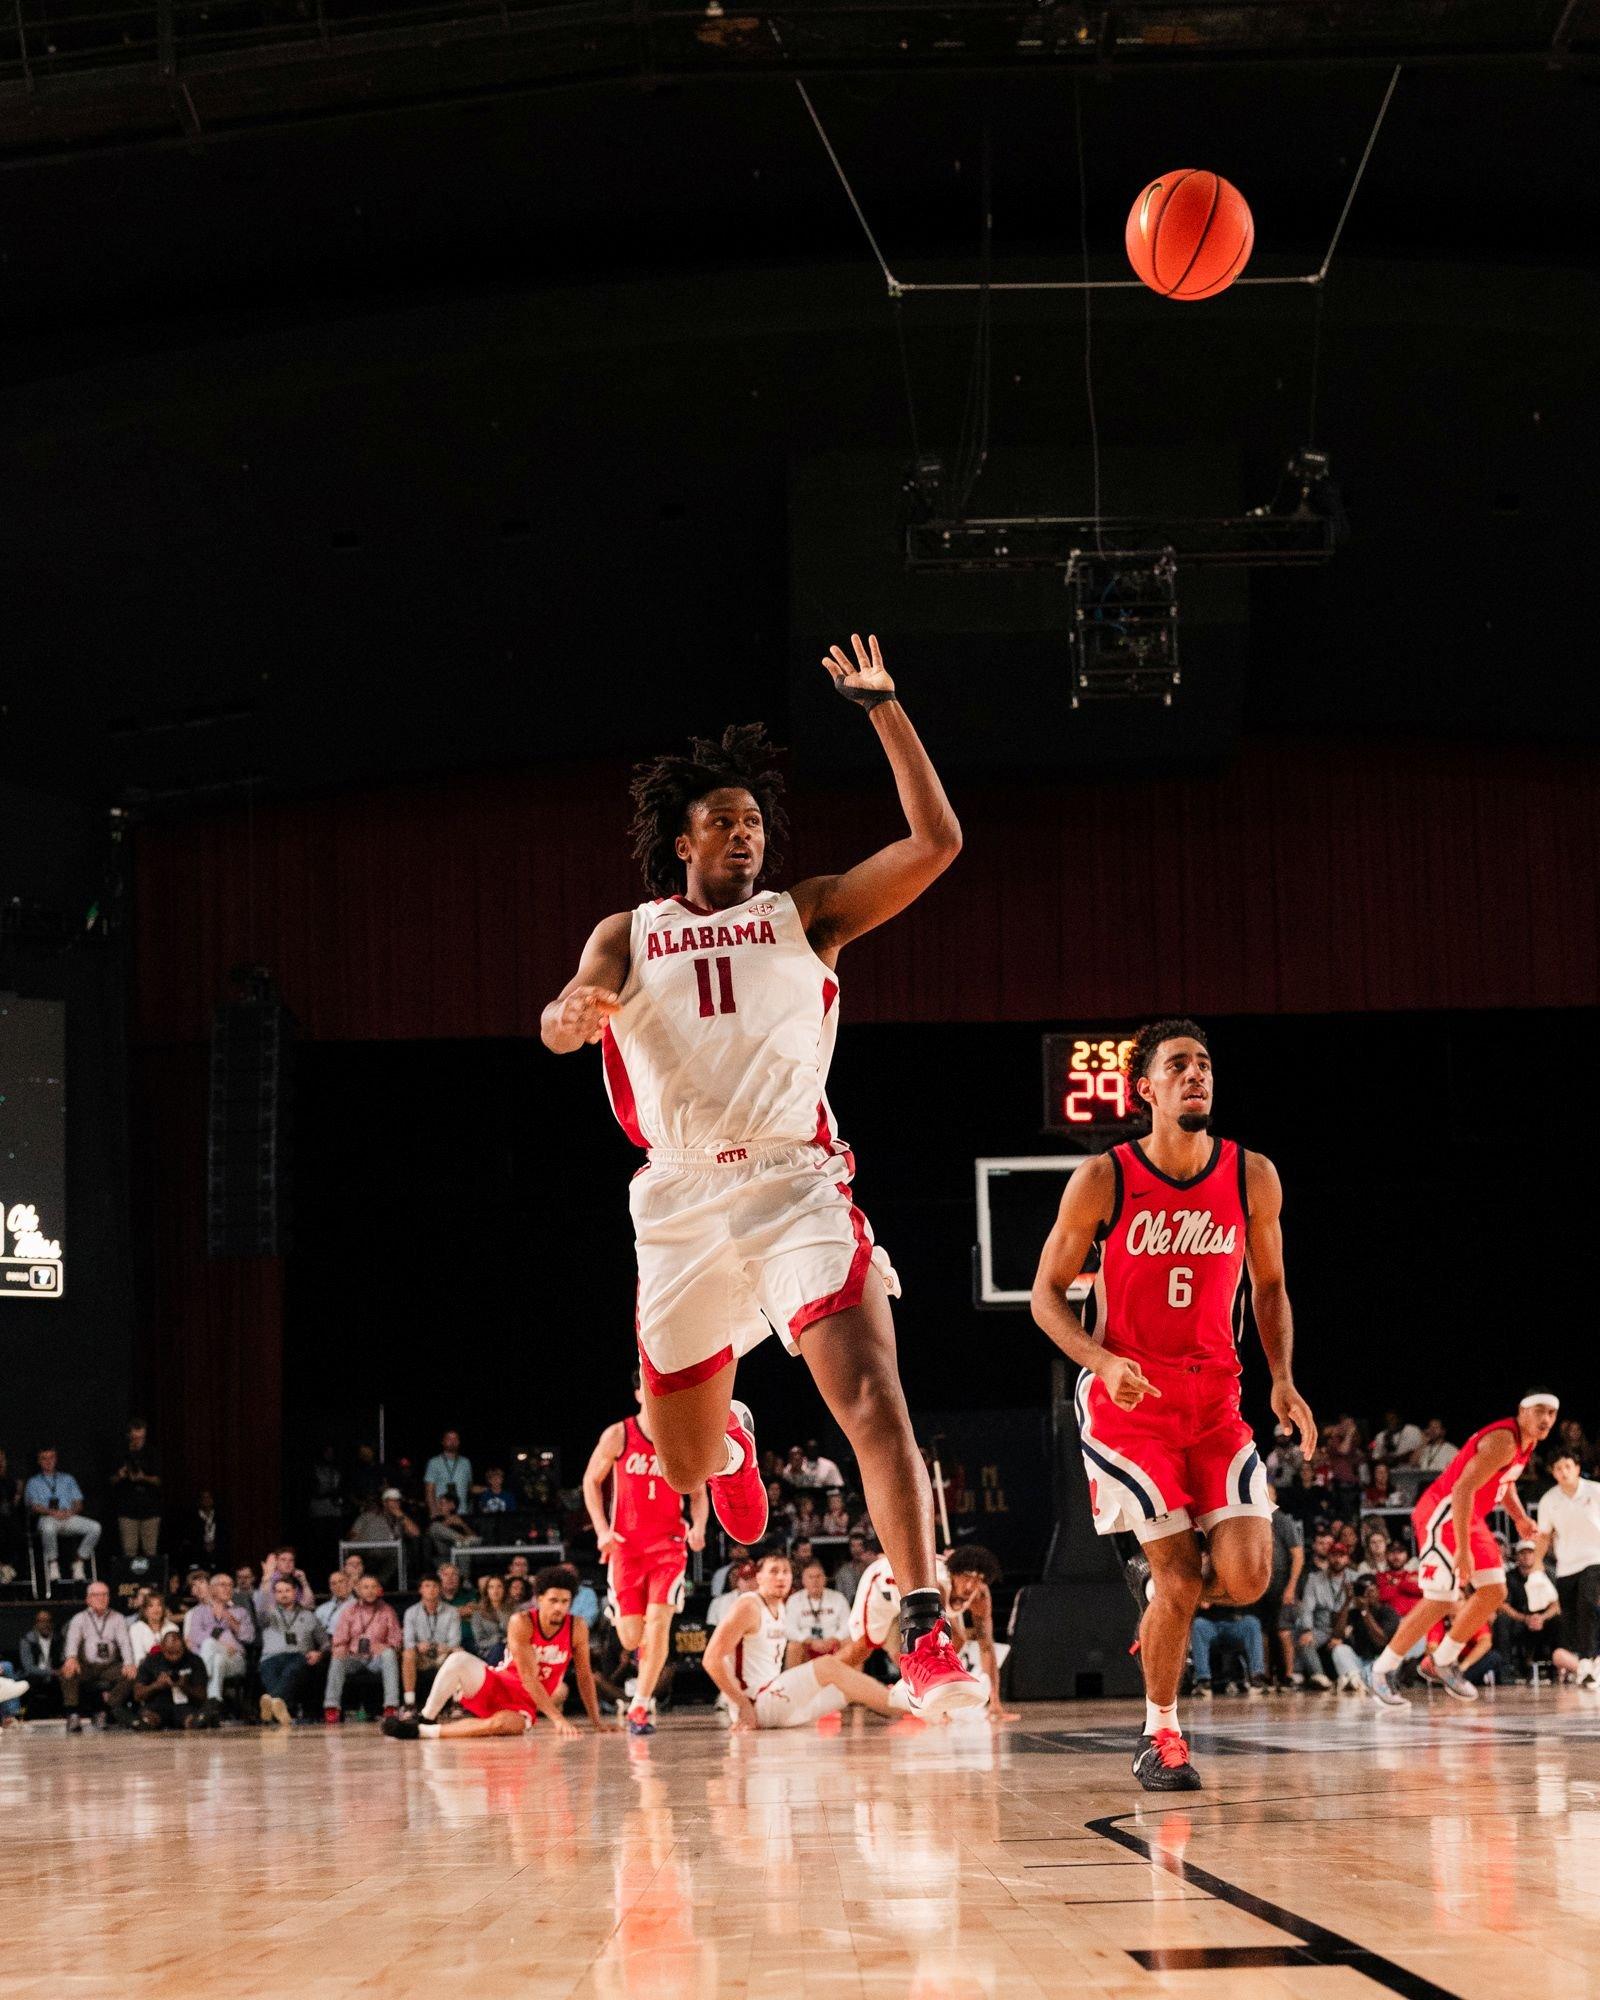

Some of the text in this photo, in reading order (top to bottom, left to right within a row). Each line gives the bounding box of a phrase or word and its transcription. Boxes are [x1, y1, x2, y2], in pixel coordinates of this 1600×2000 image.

[647, 920, 777, 960] ALABAMA
[693, 956, 737, 1018] 11
[1066, 1071, 1126, 1121] 29
[715, 1147, 749, 1164] RTR
[1126, 1210, 1237, 1256] Ole Miss
[1168, 1266, 1194, 1308] 6
[647, 1479, 656, 1500] 1
